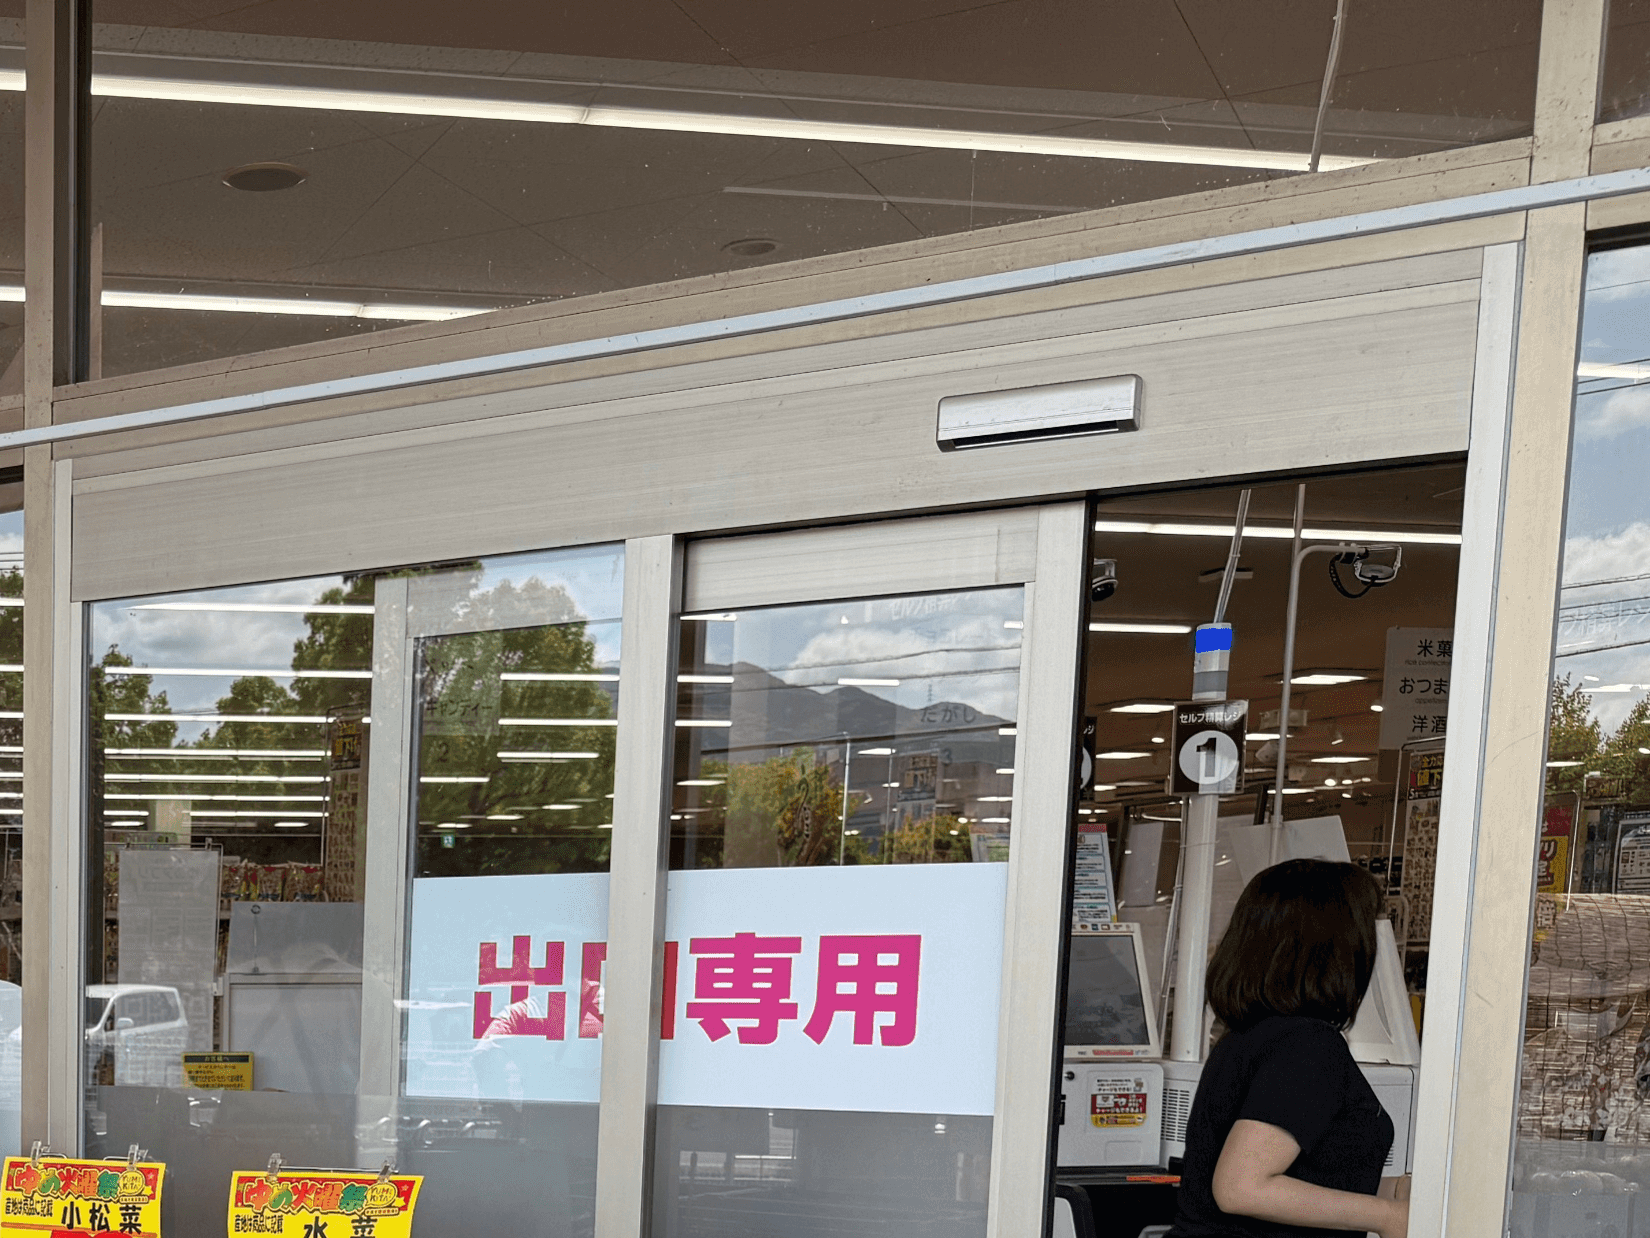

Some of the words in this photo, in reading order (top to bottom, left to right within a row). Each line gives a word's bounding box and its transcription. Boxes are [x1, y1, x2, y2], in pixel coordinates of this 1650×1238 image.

[1417, 638, 1453, 658] 米菓
[1399, 676, 1449, 694] おつま
[1179, 710, 1240, 724] セルフ精算レジ
[1412, 714, 1447, 734] 洋酒
[1196, 736, 1217, 778] 1
[61, 1201, 142, 1234] 小松菜
